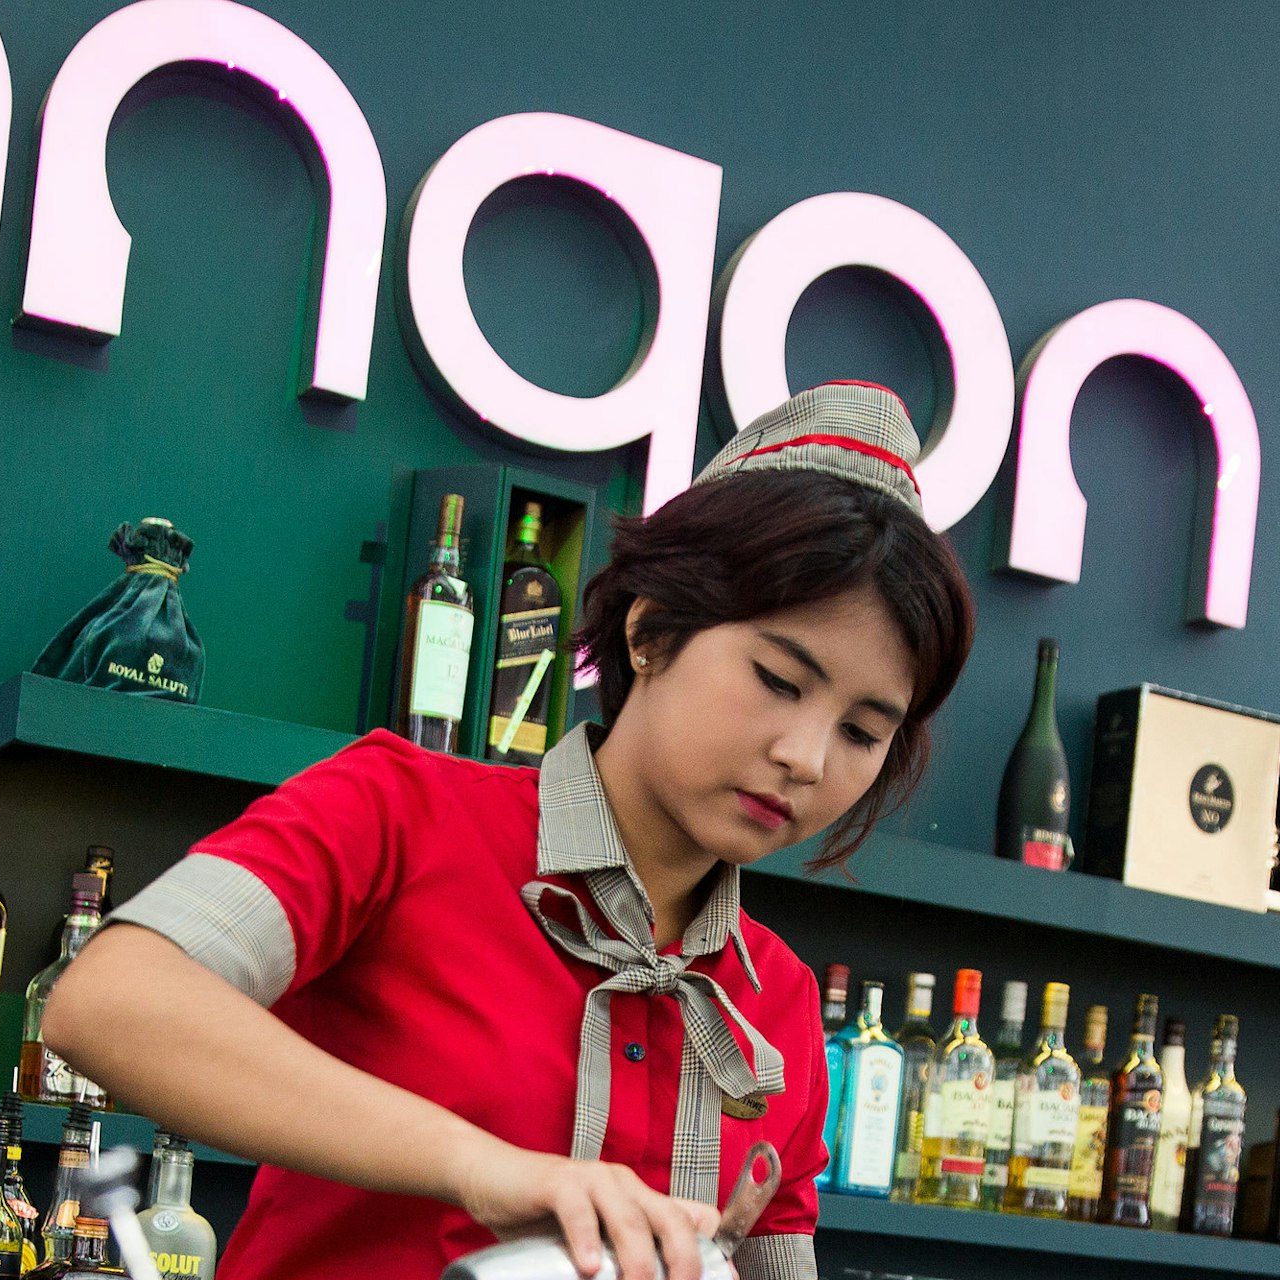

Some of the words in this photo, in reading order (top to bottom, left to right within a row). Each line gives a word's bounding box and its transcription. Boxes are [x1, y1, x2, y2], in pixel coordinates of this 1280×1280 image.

[508, 627, 529, 642] Blue
[530, 624, 554, 639] Label
[108, 662, 145, 683] ROYAL
[148, 674, 189, 698] SALUTE
[150, 1251, 202, 1275] SOLUT
